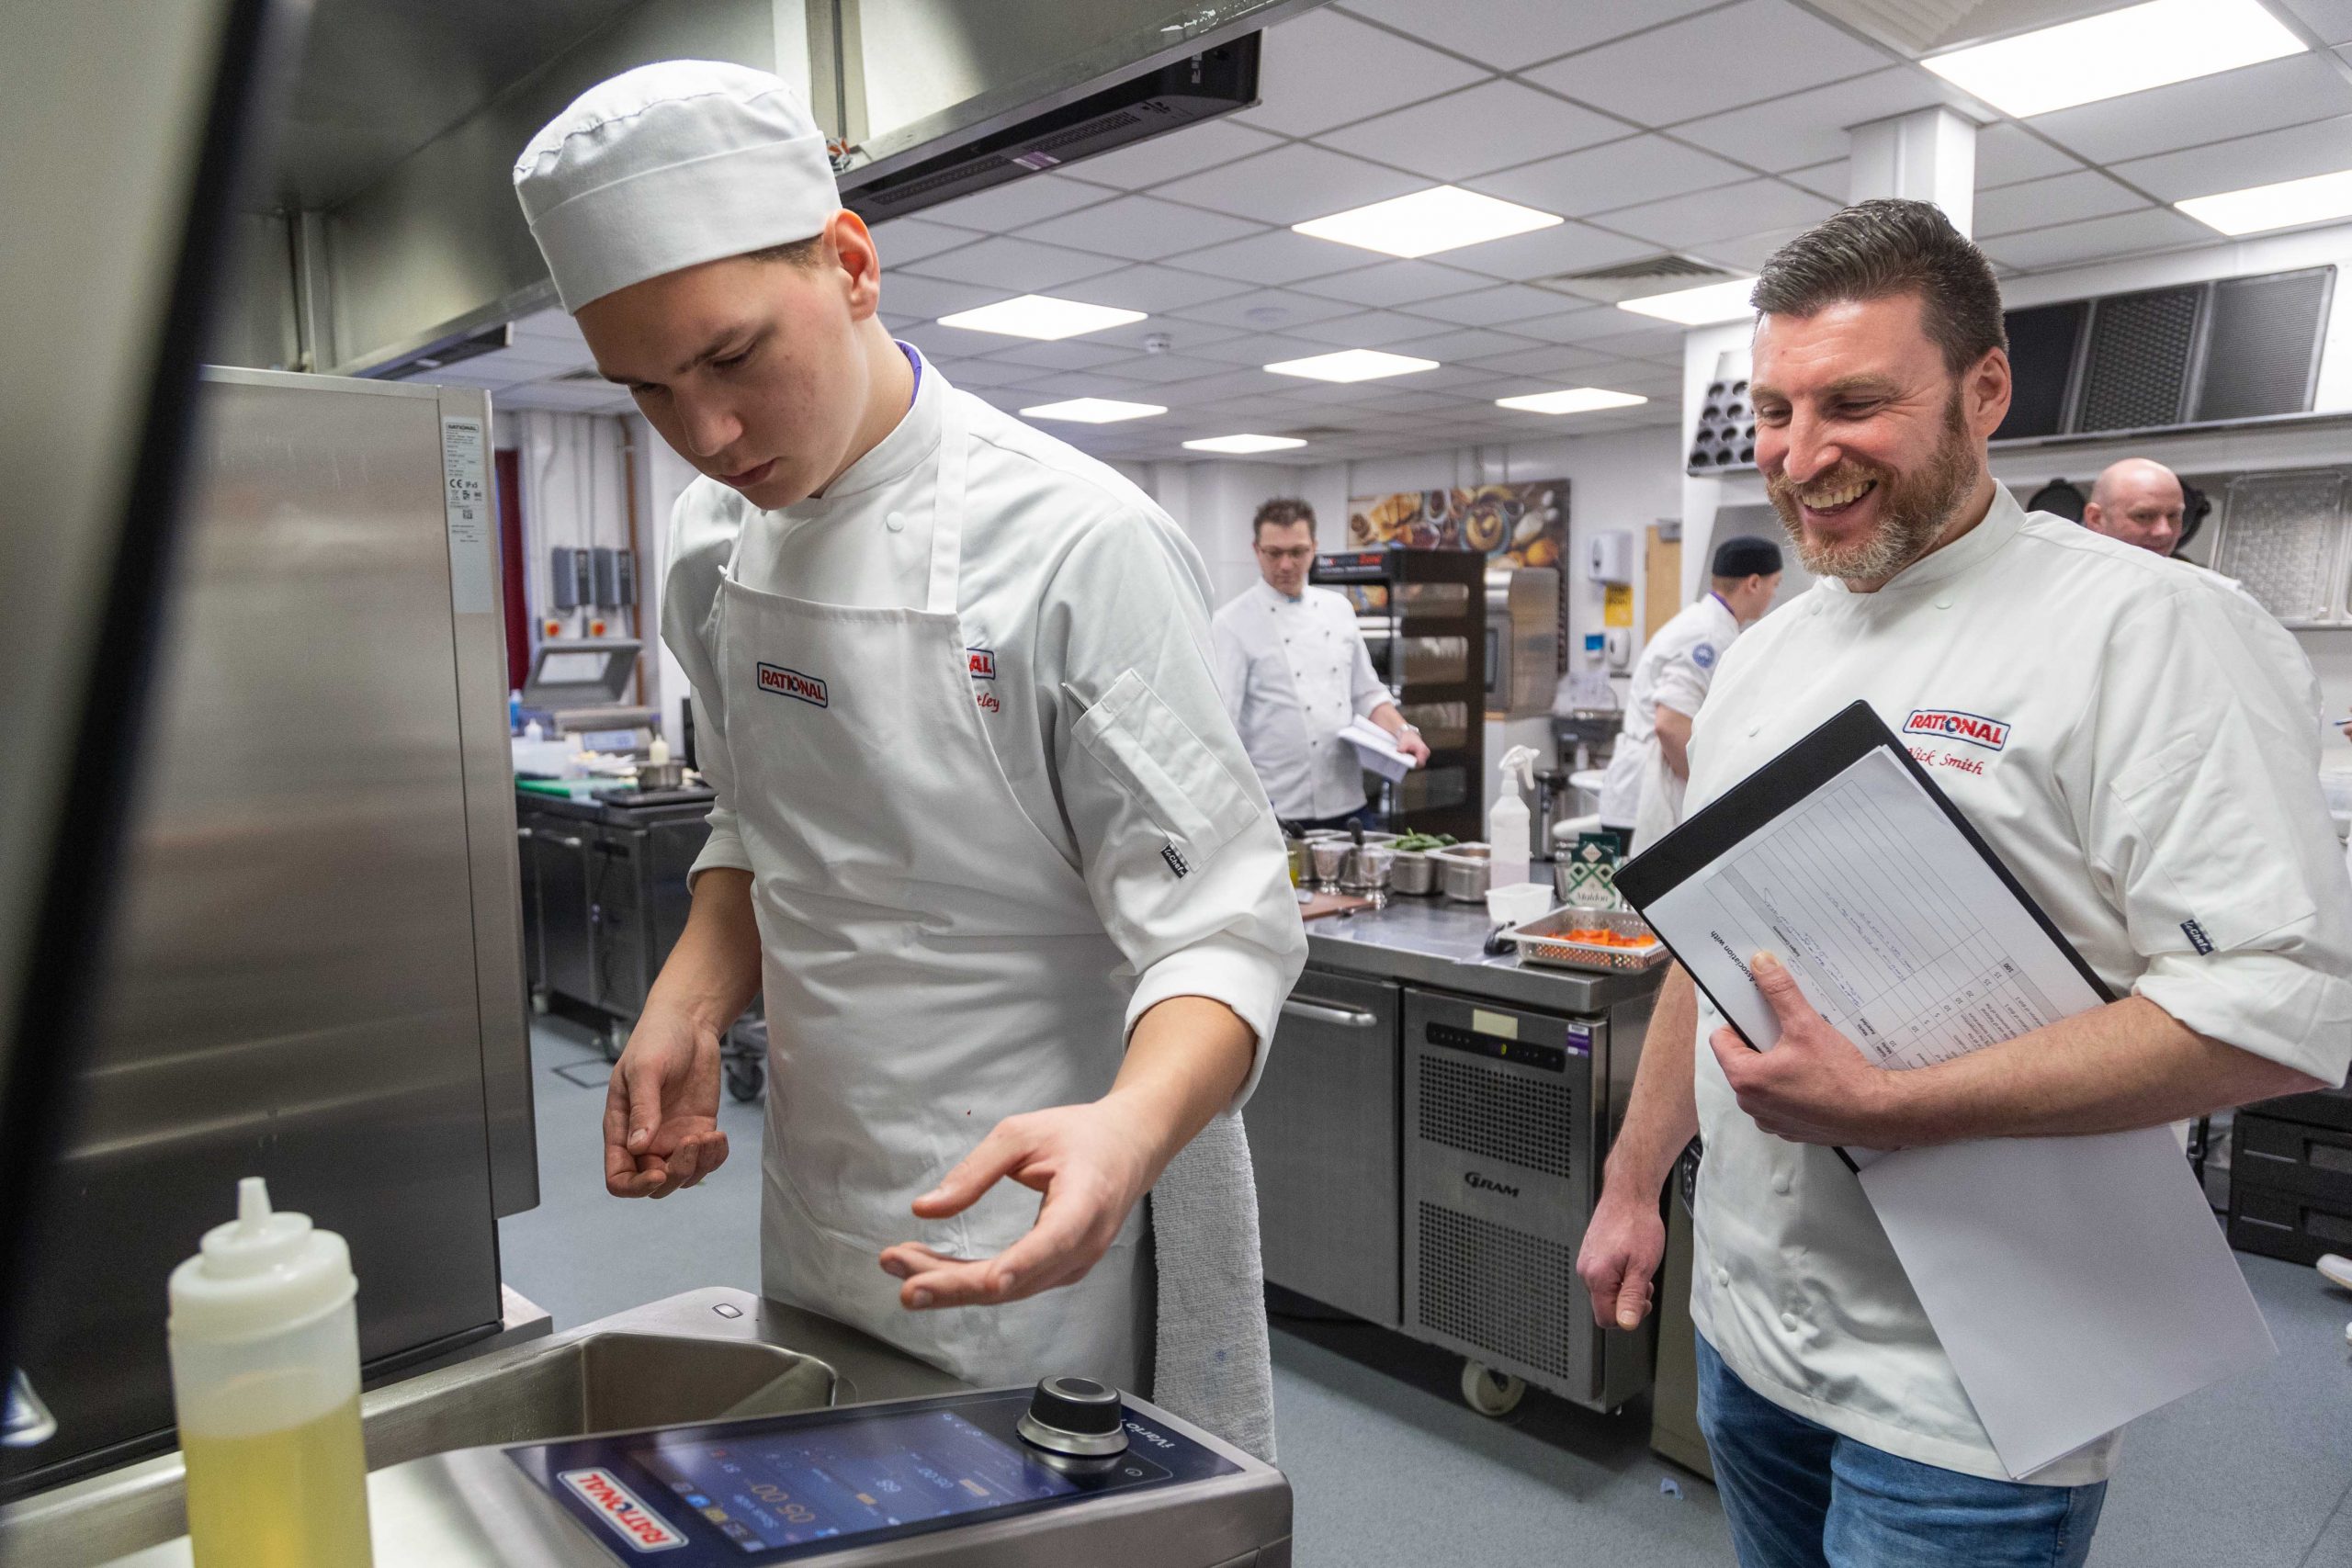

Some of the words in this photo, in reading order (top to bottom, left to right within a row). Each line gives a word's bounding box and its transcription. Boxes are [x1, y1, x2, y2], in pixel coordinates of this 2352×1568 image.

[761, 669, 826, 701] RATIONAL
[1910, 714, 2003, 745] RATIONAL
[1939, 752, 1985, 775] Smith
[1711, 931, 1724, 945] with
[1724, 945, 1756, 981] Association
[2003, 963, 2013, 972] 100
[1125, 1423, 1175, 1449] iVario
[577, 1472, 671, 1544] RATIONAL
